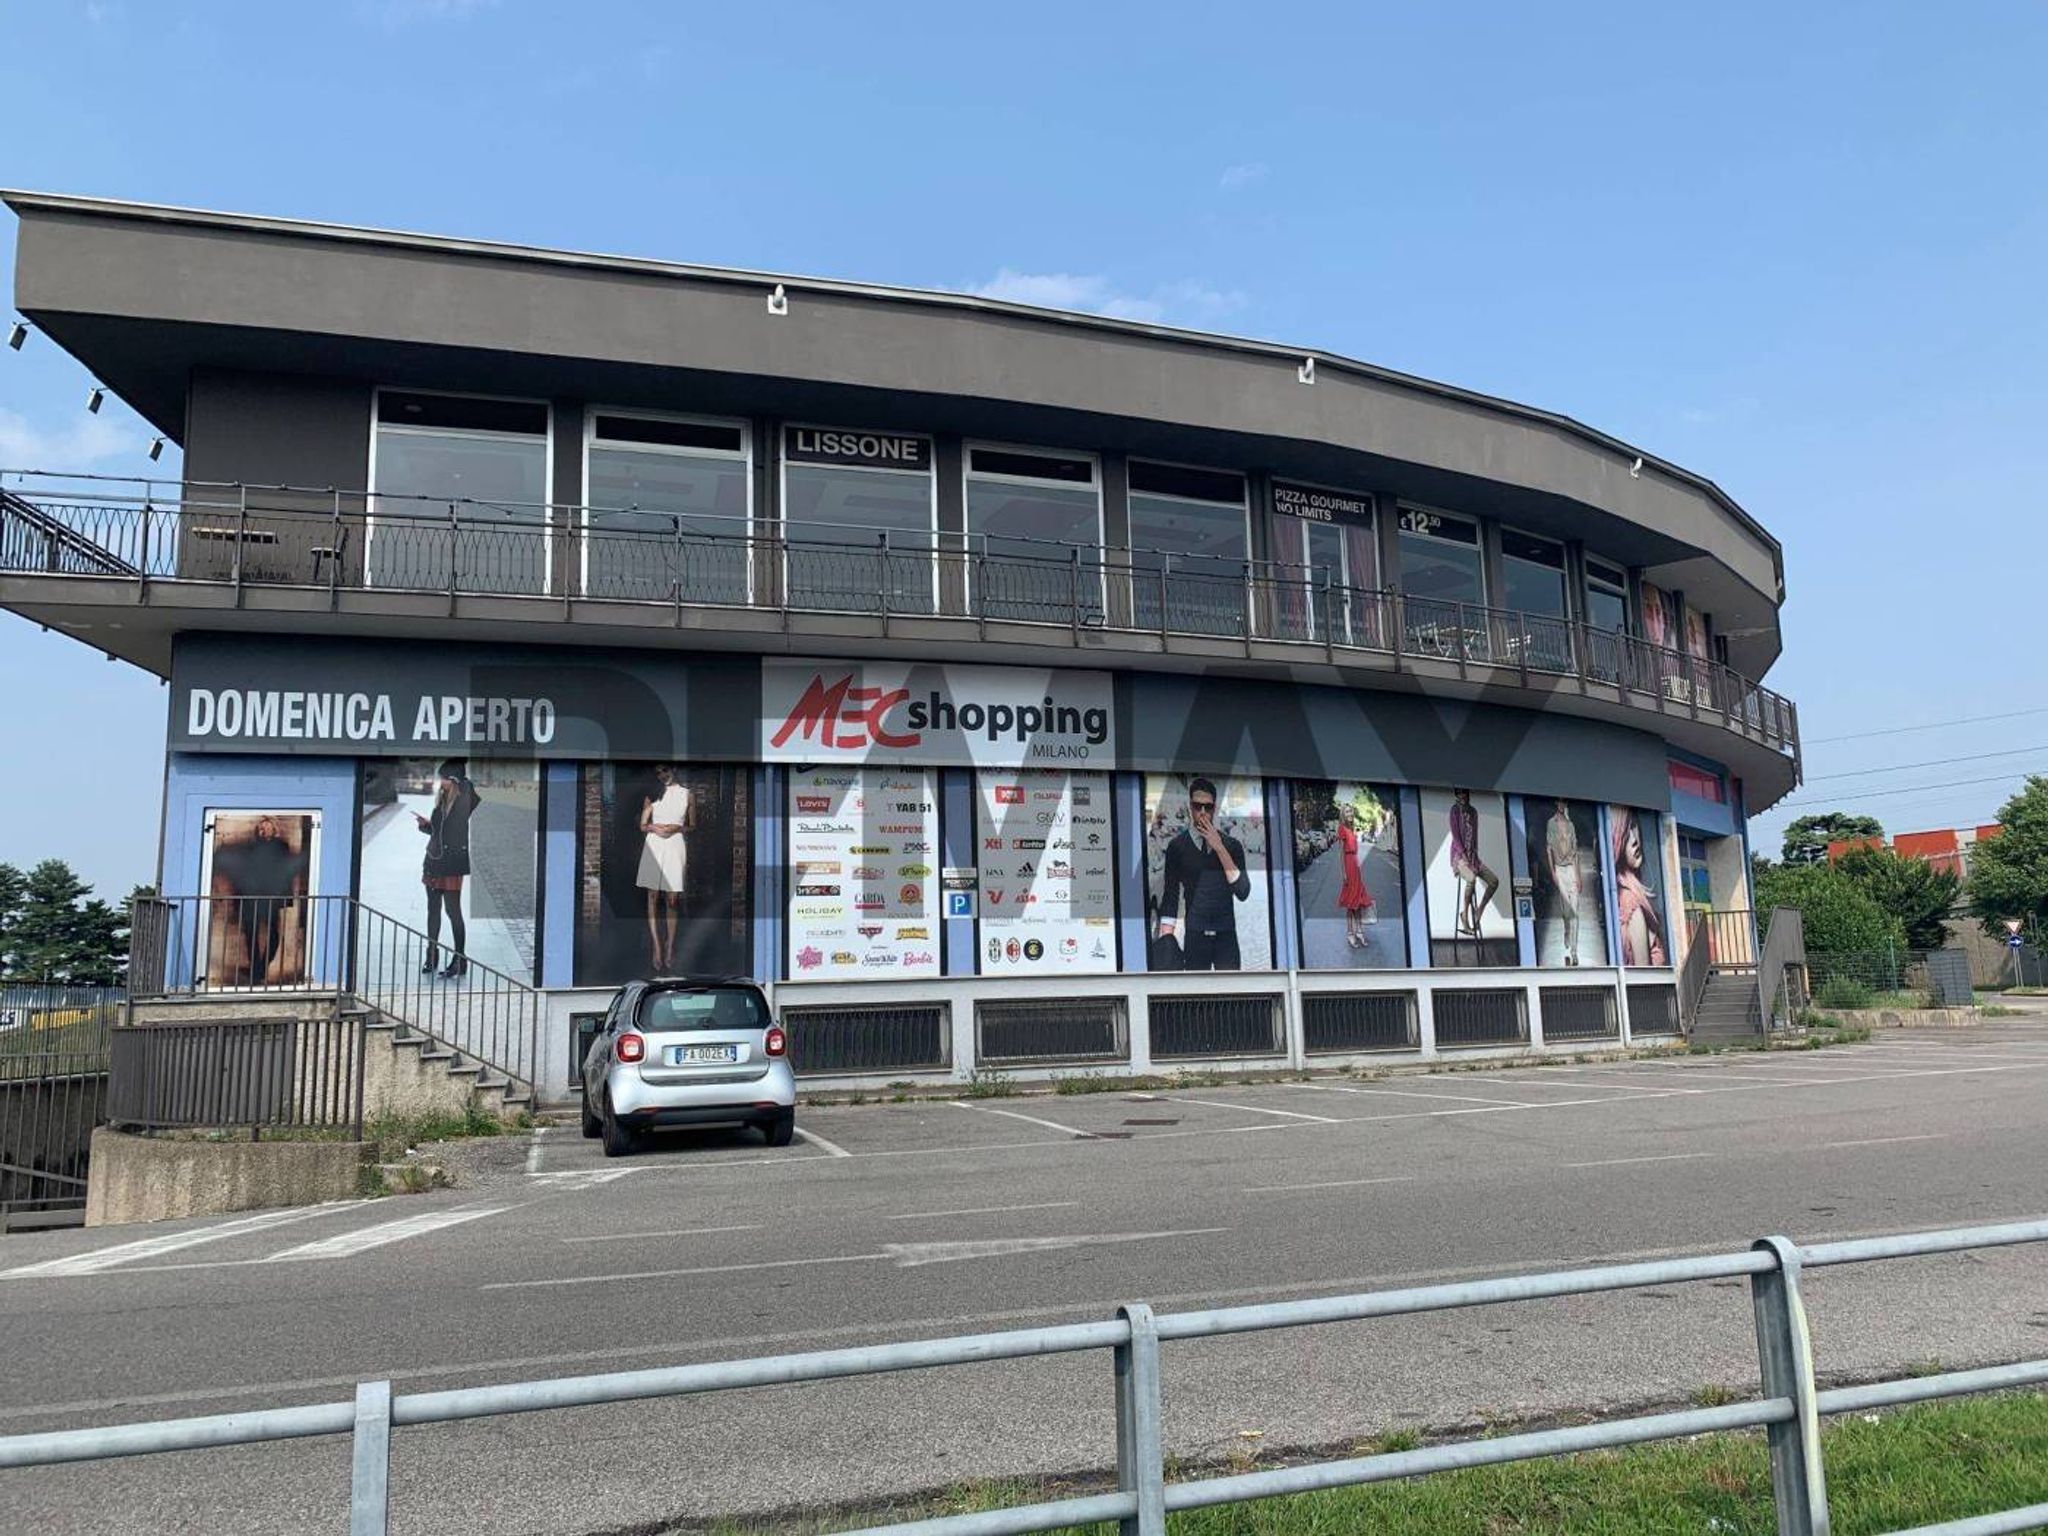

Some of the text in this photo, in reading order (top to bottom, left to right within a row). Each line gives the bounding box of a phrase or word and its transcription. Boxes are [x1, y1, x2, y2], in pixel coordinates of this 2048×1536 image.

[797, 431, 918, 460] LISSONE
[1275, 488, 1366, 513] PIZZA GOURMET
[1276, 501, 1332, 521] NO LIMITS
[188, 689, 556, 743] DOMENICA APERTO
[770, 673, 1107, 748] MEC shopping
[1032, 744, 1089, 758] MILANO
[896, 803, 916, 813] YAB
[920, 803, 932, 813] 51
